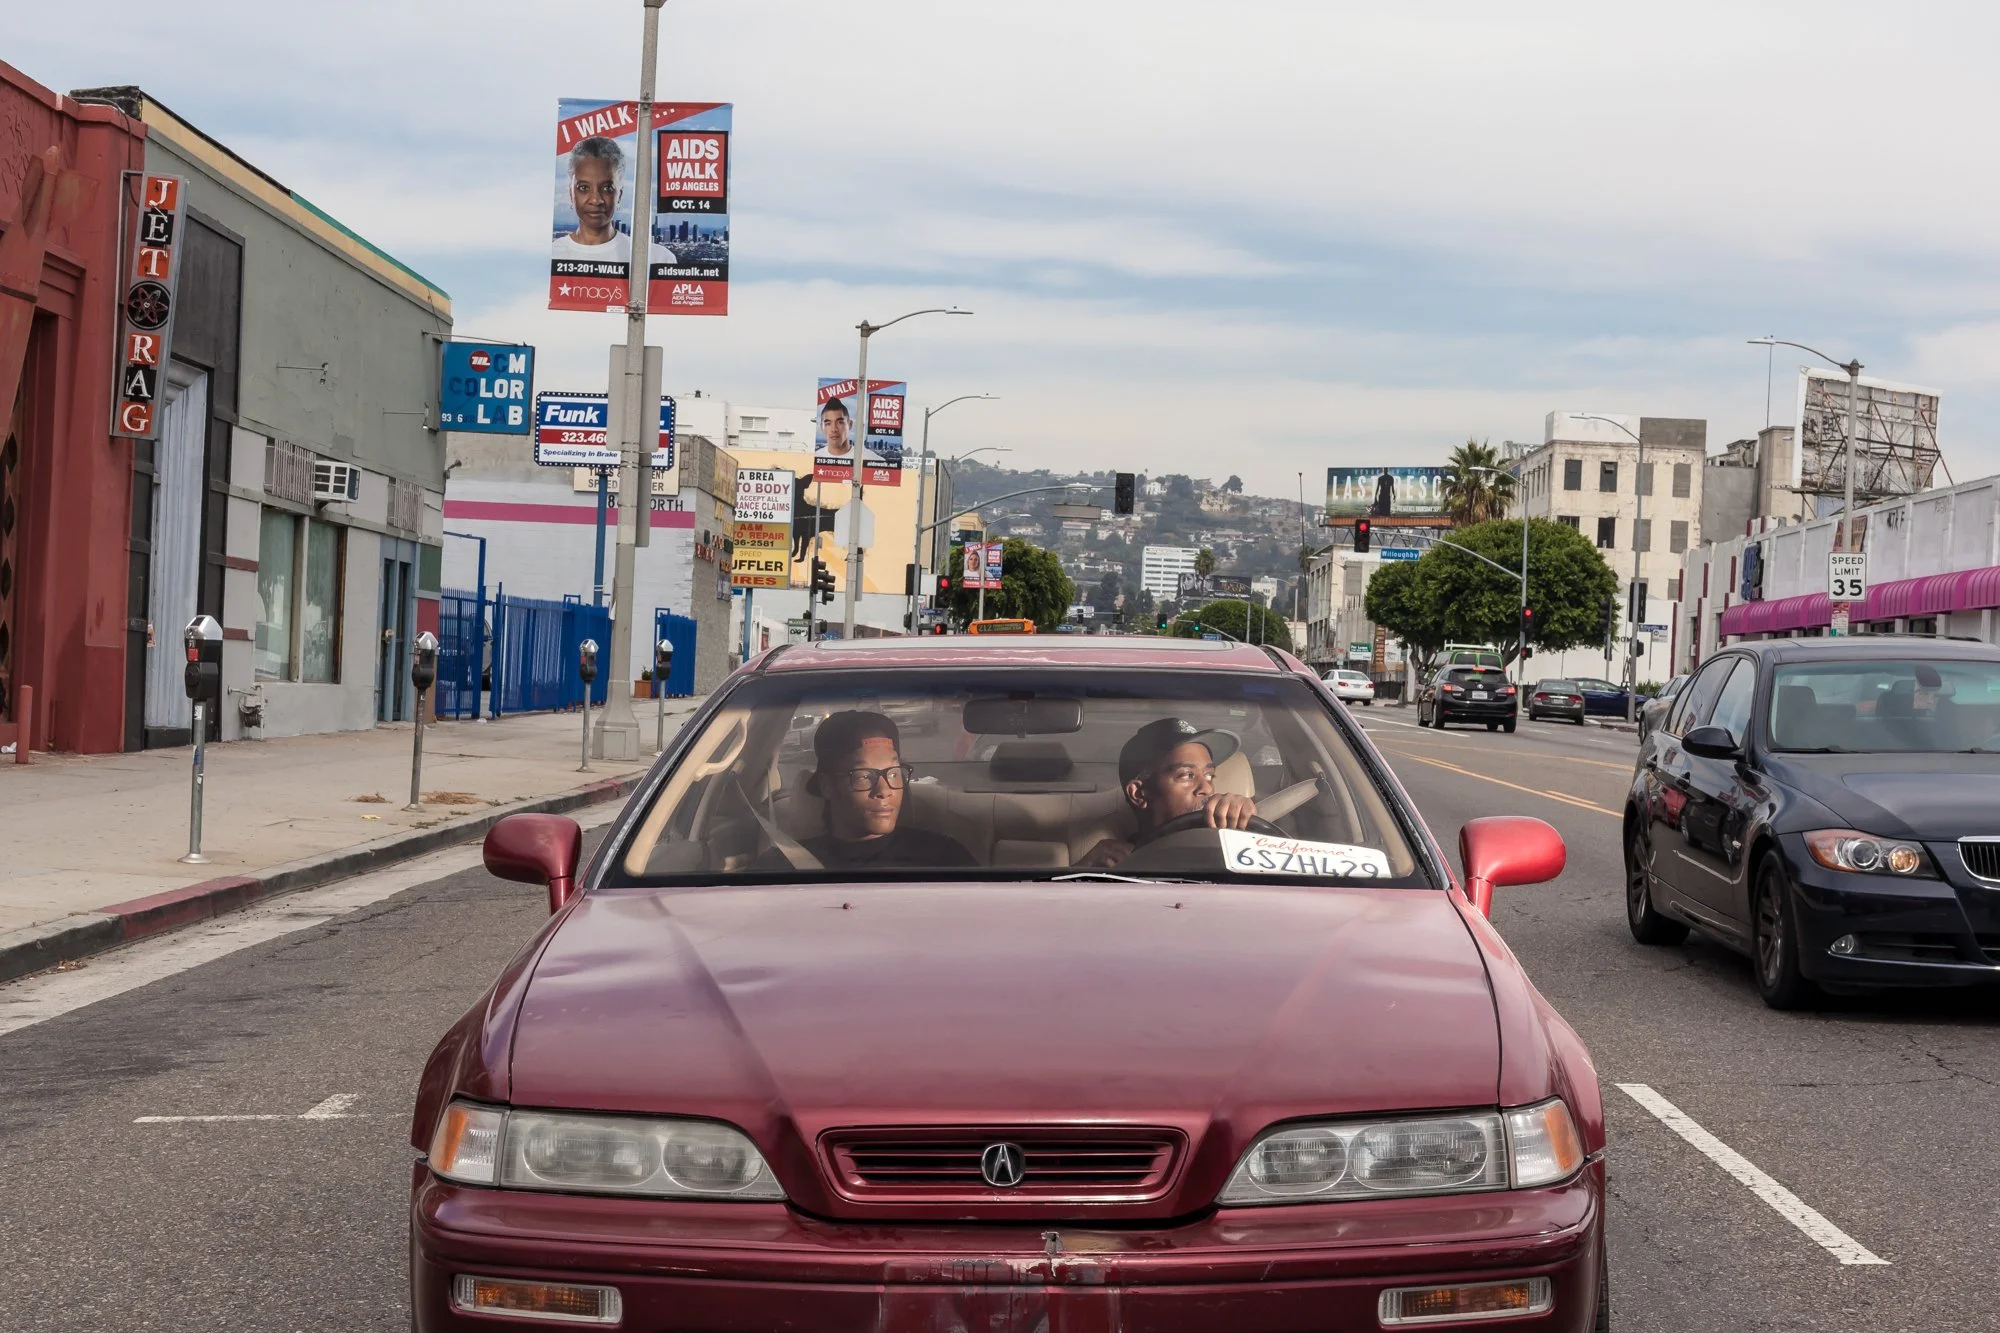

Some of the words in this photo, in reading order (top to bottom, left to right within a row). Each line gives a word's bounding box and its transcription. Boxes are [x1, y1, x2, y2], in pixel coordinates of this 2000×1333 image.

[561, 124, 570, 143] I
[574, 104, 634, 138] WALK
[666, 138, 720, 160] AIDS
[666, 162, 718, 180] WALK
[666, 182, 680, 191] LOS
[682, 182, 719, 192] ANGELES
[672, 200, 696, 209] OCT.
[698, 200, 710, 210] 14
[556, 262, 625, 275] 213-201-WALK
[658, 266, 720, 277] aidswalk.net
[572, 282, 622, 302] macy's
[672, 284, 704, 294] APLA
[819, 390, 824, 400] I
[826, 381, 855, 397] WALK
[873, 398, 900, 410] AIDS
[544, 405, 600, 424] Funk
[873, 410, 899, 420] WALK
[544, 448, 586, 457] Specializing
[749, 472, 774, 481] BREA
[737, 483, 751, 493] TO
[755, 483, 790, 494] BODY
[650, 499, 683, 512] ORTH
[736, 502, 759, 510] RANCE
[762, 503, 790, 511] CLAIMS
[735, 510, 774, 520] 36-9166
[749, 532, 784, 540] REPAIR
[734, 539, 774, 547] 36-2581
[1382, 551, 1418, 559] Willoughby
[732, 560, 784, 572] UFFLER
[733, 576, 777, 585] IRES
[1832, 579, 1862, 596] 35
[1256, 837, 1347, 858] California
[1236, 848, 1380, 878] 6SZH429
